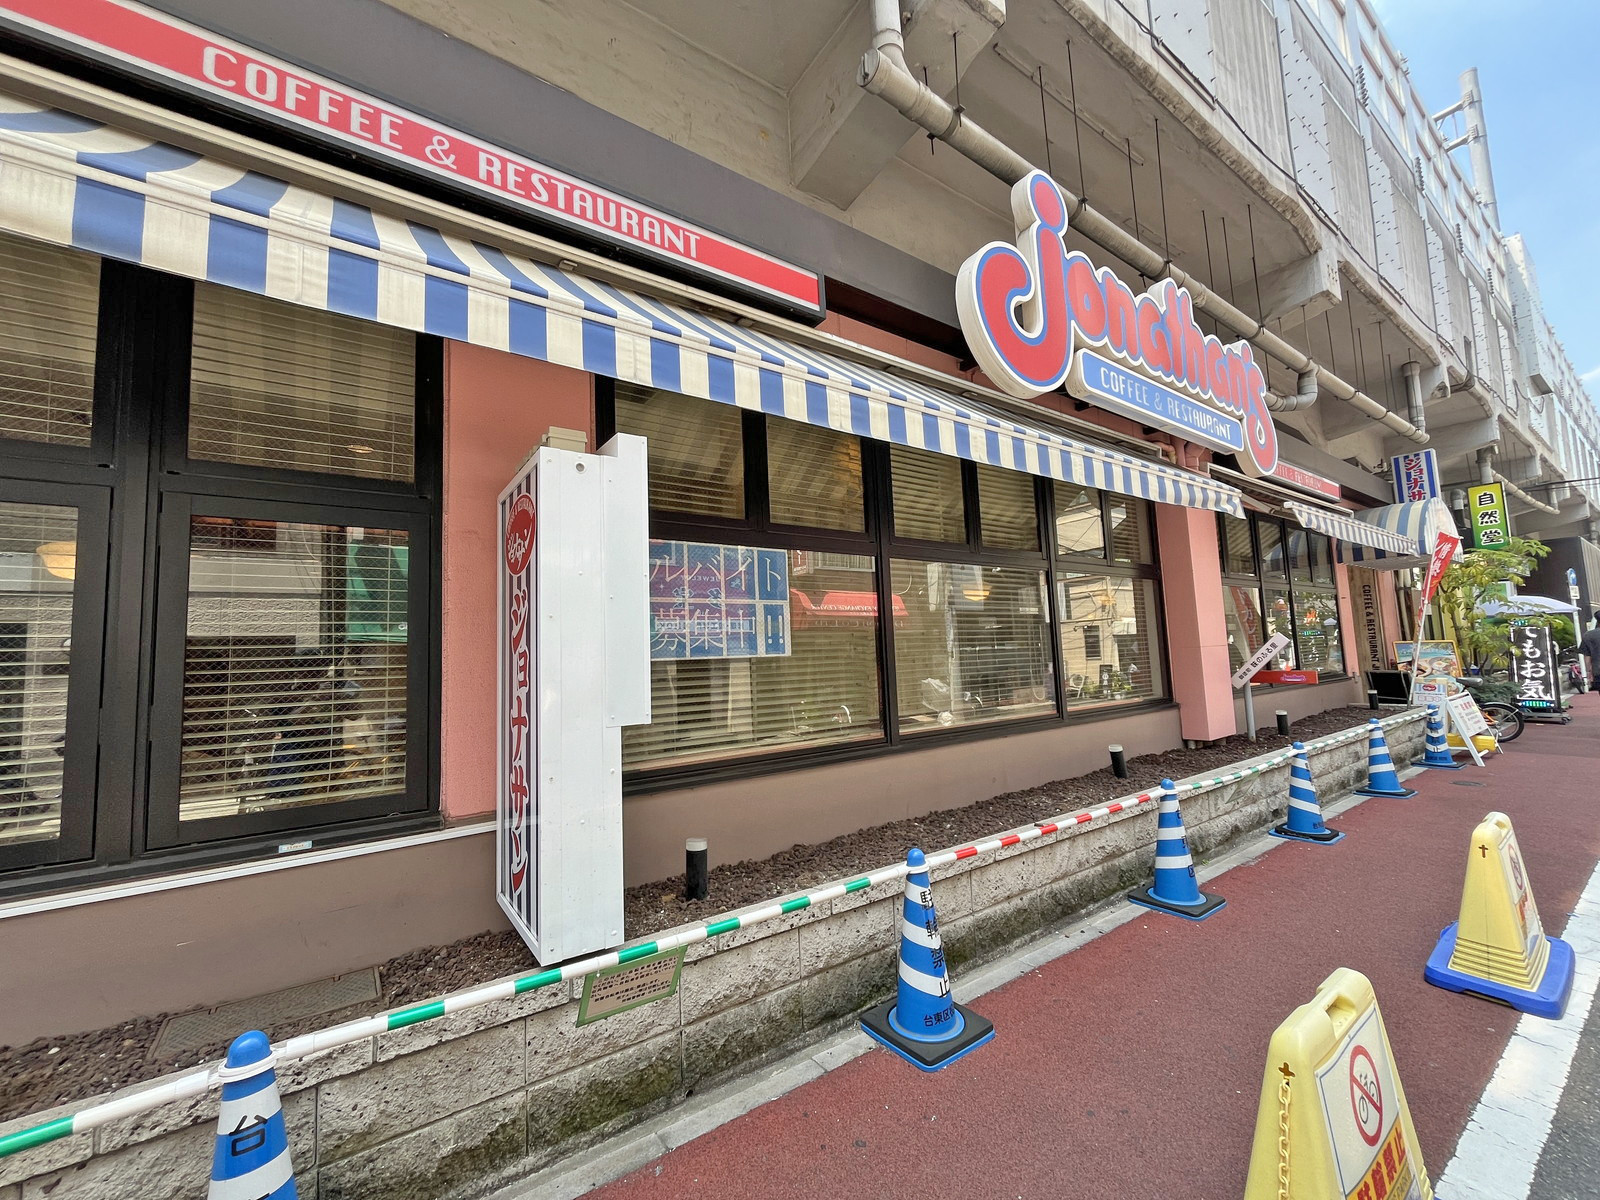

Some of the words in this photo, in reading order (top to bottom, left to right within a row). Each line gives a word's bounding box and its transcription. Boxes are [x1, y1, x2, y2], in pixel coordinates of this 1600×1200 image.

[202, 46, 403, 150] COFFEE
[424, 135, 457, 169] &
[478, 151, 700, 258] RESTAURANT
[1101, 367, 1149, 406] COFFEE
[1154, 392, 1164, 411] &
[1167, 396, 1231, 440] RESTAURANT
[1478, 491, 1504, 546] 自然堂
[1362, 584, 1374, 610] COFFEE
[1367, 618, 1379, 662] RESTAURANT
[509, 587, 529, 893] ジョナサン
